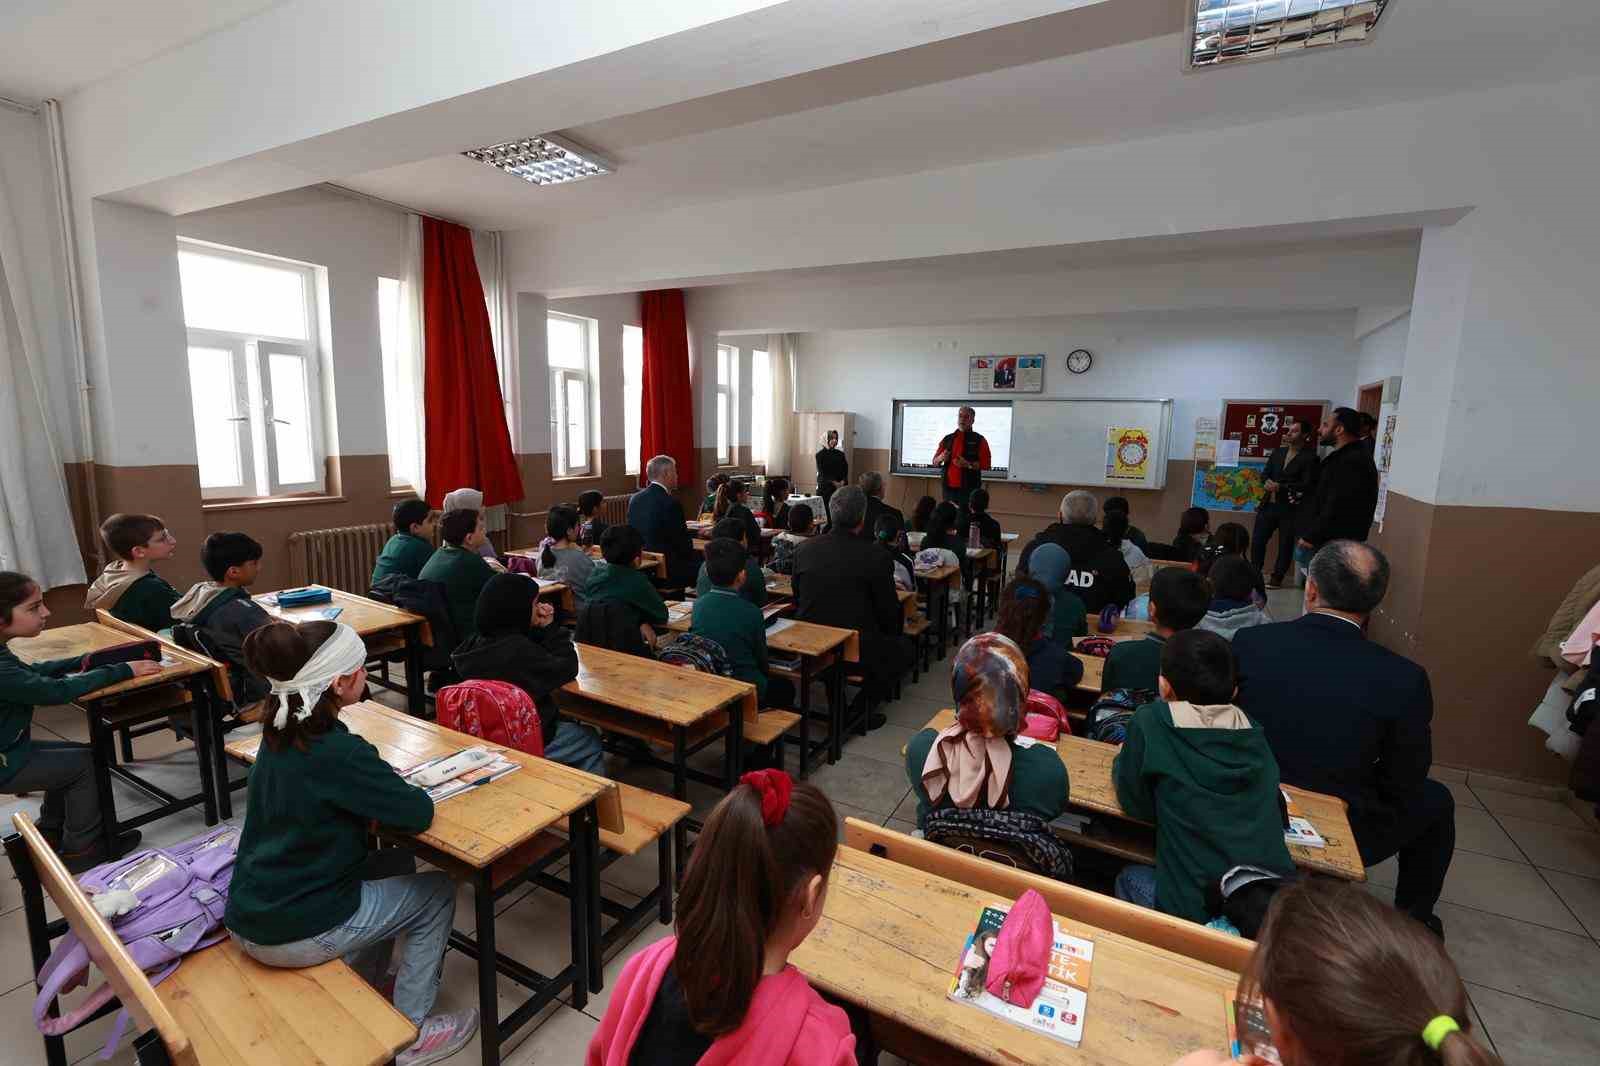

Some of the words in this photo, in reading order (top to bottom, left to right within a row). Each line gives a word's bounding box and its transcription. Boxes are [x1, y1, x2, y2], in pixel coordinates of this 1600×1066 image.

[1064, 569, 1094, 588] AD
[1049, 951, 1078, 967] TE-
[1048, 963, 1077, 983] TİK
